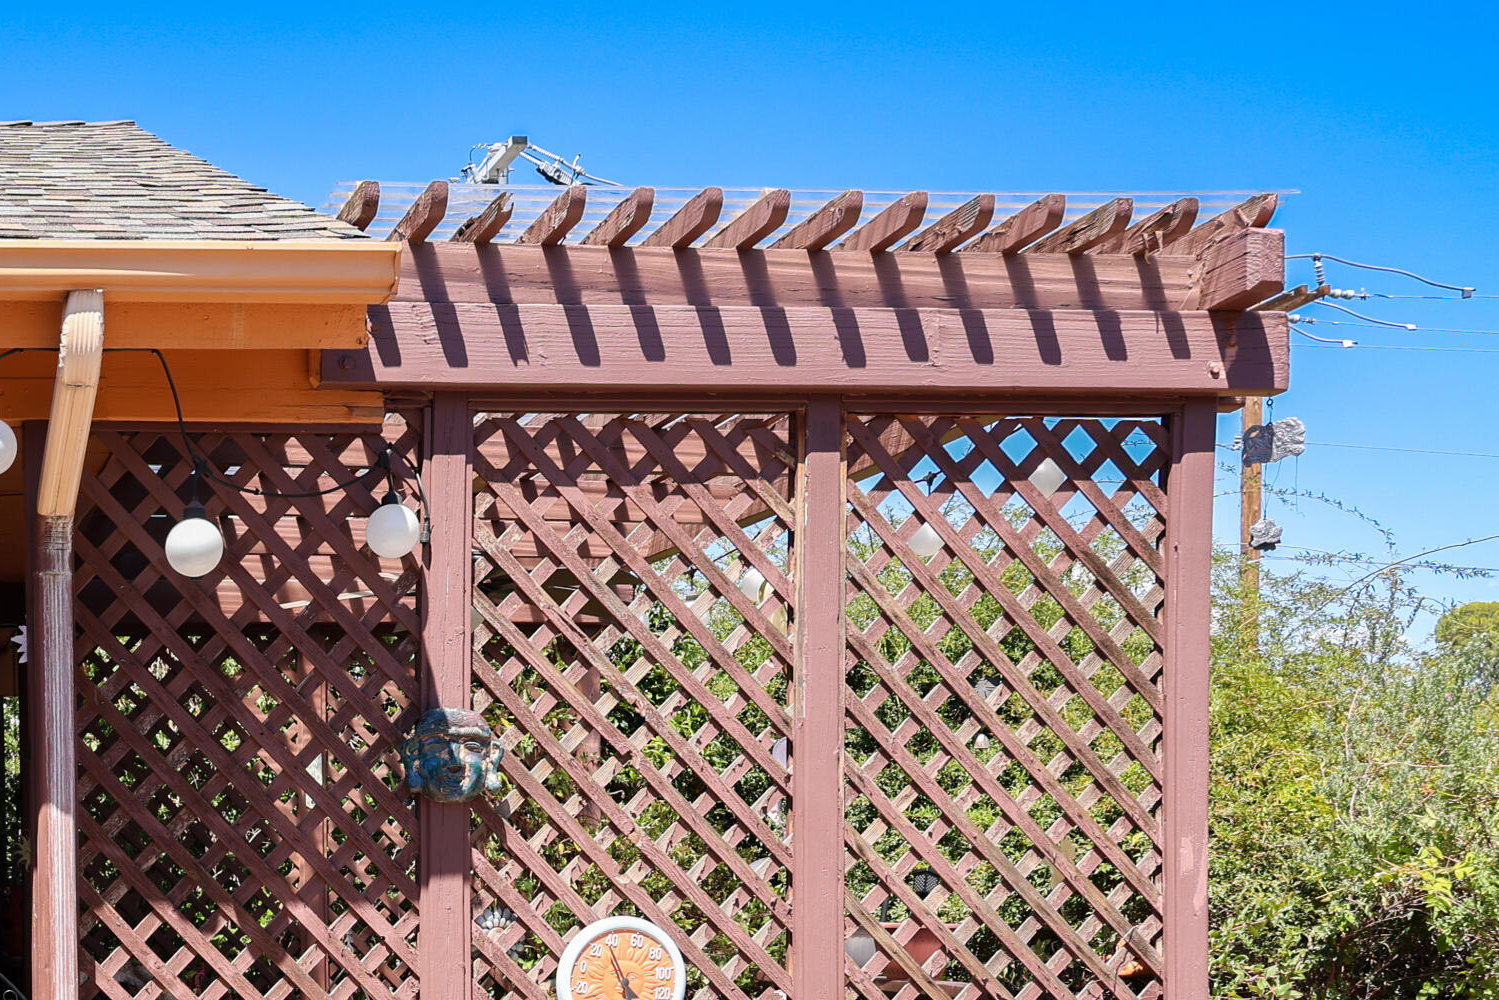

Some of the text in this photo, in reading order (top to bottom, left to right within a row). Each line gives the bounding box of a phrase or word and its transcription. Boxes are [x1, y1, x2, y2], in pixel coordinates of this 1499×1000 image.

[605, 934, 619, 947] 40
[630, 935, 644, 948] 60
[591, 943, 603, 957] 20
[649, 947, 662, 960] 80
[580, 960, 587, 973] 0
[655, 967, 671, 980] 100
[654, 987, 670, 1000] 120
